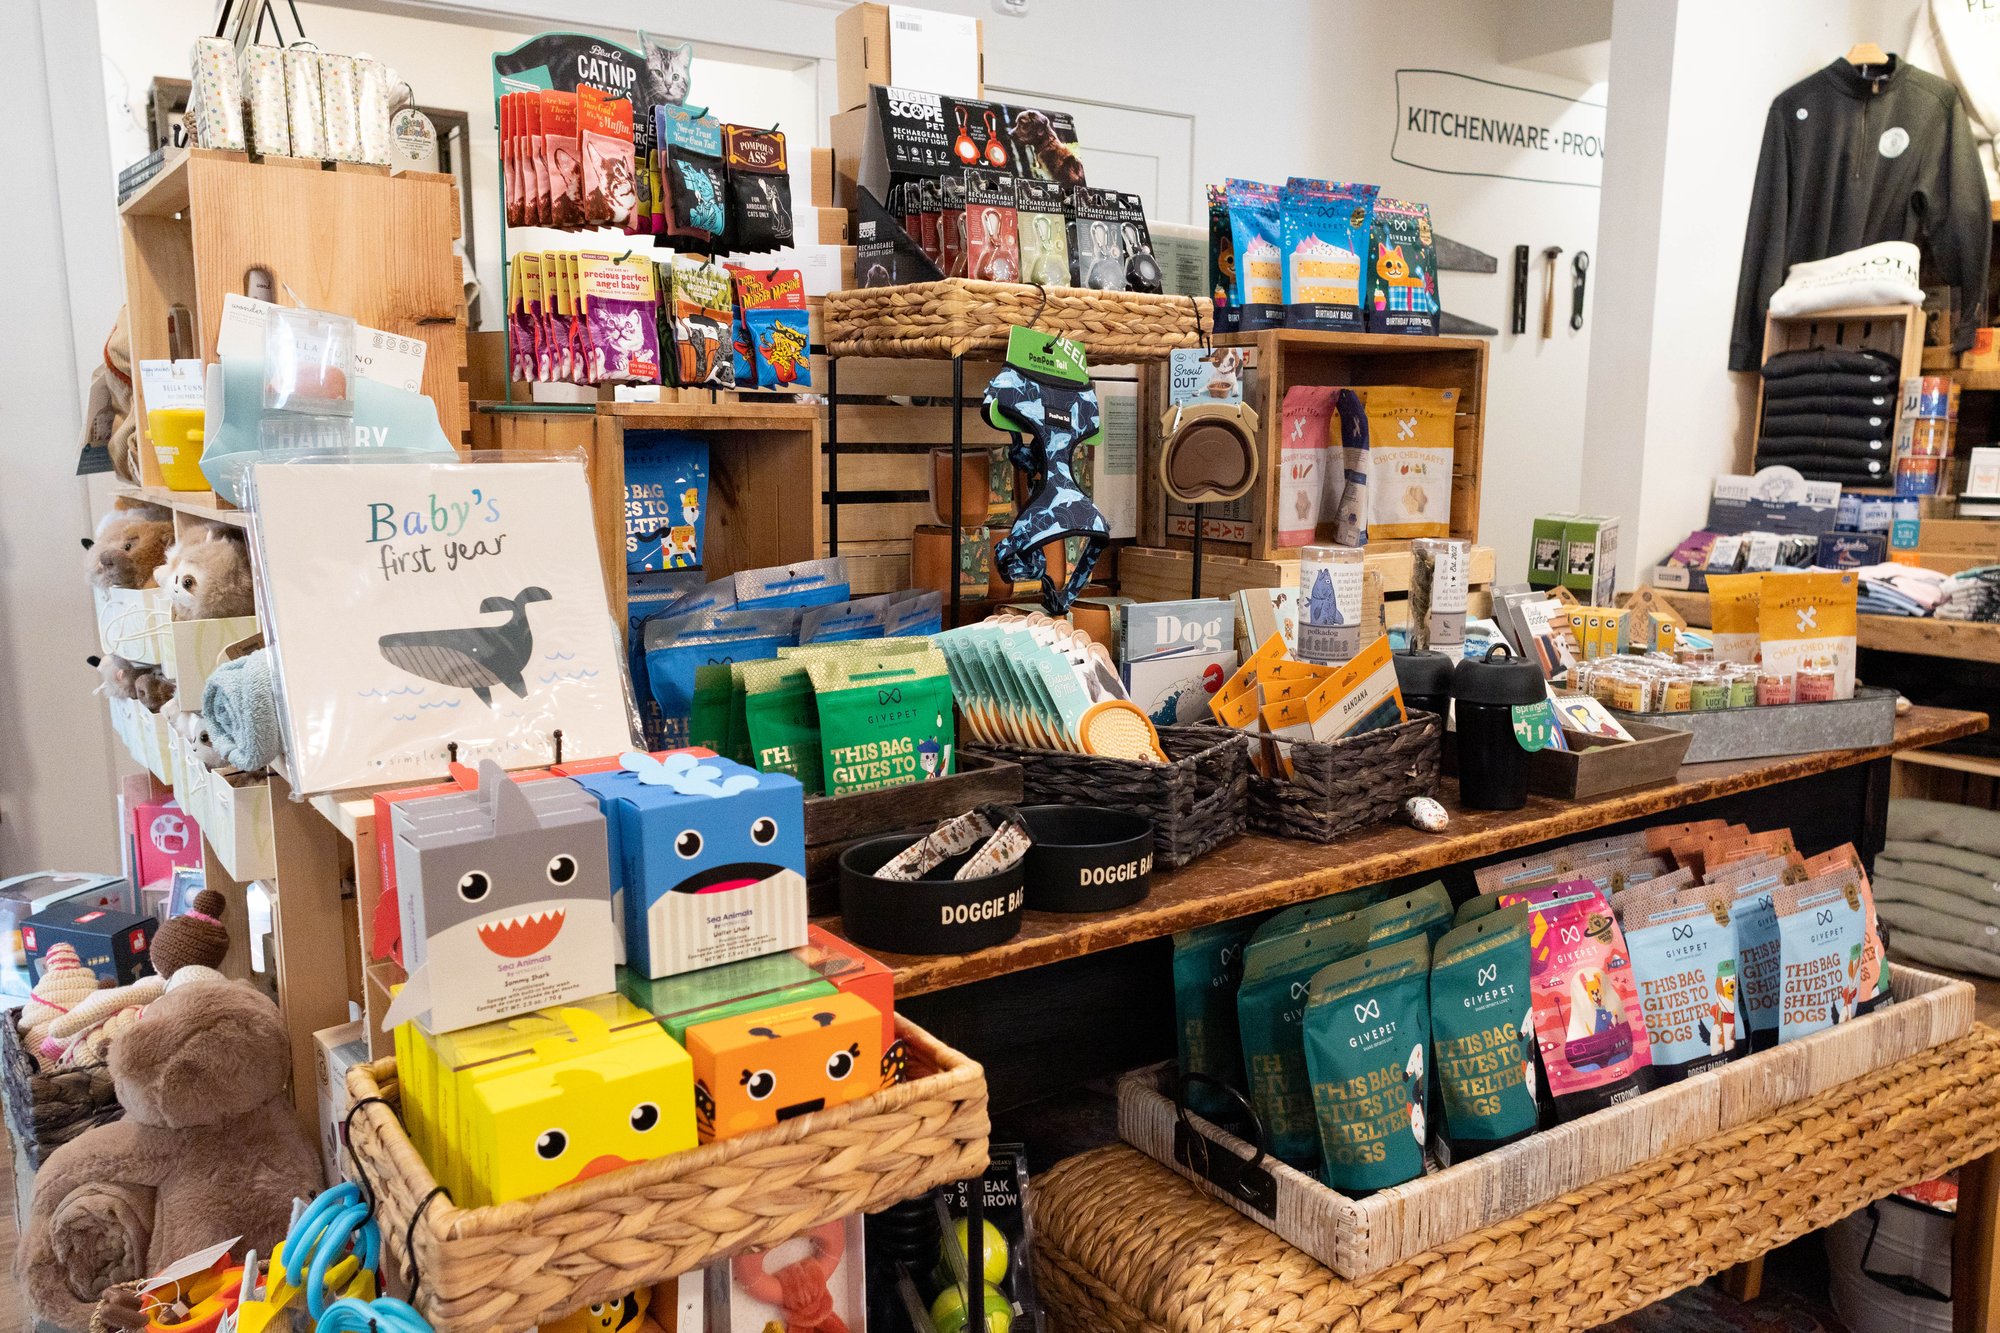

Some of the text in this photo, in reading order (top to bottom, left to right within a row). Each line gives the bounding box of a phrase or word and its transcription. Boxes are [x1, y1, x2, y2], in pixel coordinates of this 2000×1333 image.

[589, 45, 623, 62] Blue Q
[577, 54, 637, 90] CATNIP
[888, 101, 945, 123] SCOPE
[676, 123, 712, 139] Never Trust
[892, 126, 948, 141] RECHARGEABLE
[925, 121, 945, 132] PET
[1408, 106, 1549, 151] KITCHENWARE
[672, 131, 718, 150] Your Own Tail
[739, 141, 774, 155] POMPOUS
[893, 133, 949, 147] PET SAFETY LIGHT
[747, 152, 767, 165] ASS
[967, 191, 1014, 201] RECHARGEABLE
[1019, 200, 1062, 208] RECHARGEABLE
[758, 211, 770, 219] ONLY
[1077, 207, 1119, 216] RECHARGEABLE
[858, 228, 876, 239] SCOPE
[1388, 233, 1416, 243] GIVEPET
[858, 241, 894, 252] RECHARGEABLE
[881, 248, 894, 256] LIGHT
[584, 270, 650, 283] precious perfect
[595, 280, 641, 291] angel baby
[742, 290, 771, 308] MURDER
[771, 278, 801, 301] MACHINE
[1315, 309, 1354, 320] BIRTHDAY BASH
[1386, 317, 1408, 326] BIRTHDAY
[1028, 352, 1055, 367] PomPom
[1055, 359, 1068, 370] Tail
[1174, 363, 1203, 377] Snout
[1173, 377, 1198, 389] OUT
[1414, 408, 1434, 418] PETS
[631, 484, 665, 499] BAG
[365, 488, 501, 543] Baby's
[644, 500, 669, 515] TO
[377, 531, 508, 582] first year
[1812, 596, 1835, 606] PETS
[1154, 615, 1223, 653] Dog
[1307, 628, 1339, 637] polkadog
[1342, 688, 1369, 715] BANDANA
[1515, 701, 1549, 715] springer
[867, 709, 918, 725] GIVEPET
[831, 736, 914, 767] THIS BAG
[832, 755, 916, 785] GIVES TO
[1080, 860, 1138, 887] DOGGIE
[706, 909, 753, 925] Sea Animals
[941, 898, 1006, 926] DOGGIE
[713, 925, 751, 938] Walter Whale
[1810, 926, 1845, 944] GIVEPET
[1557, 945, 1599, 965] GIVEPET
[1666, 942, 1709, 959] GIVEPET
[1741, 941, 1771, 964] THIS
[497, 954, 552, 973] Sea Animals
[1785, 952, 1841, 978] THIS BAG
[504, 977, 530, 988] Sammy
[531, 971, 550, 981] Shark
[1641, 969, 1706, 996] THIS BAG
[1785, 969, 1843, 994] GIVES TO
[1463, 984, 1516, 1009] GIVEPET
[1644, 985, 1709, 1012] GIVES TO
[1784, 985, 1845, 1010] SHELTER
[1644, 1002, 1712, 1029] SHELTER
[1783, 1008, 1827, 1026] DOGS
[1349, 1021, 1398, 1049] GIVEPET
[1436, 1022, 1518, 1058] THIS BAG
[1649, 1025, 1693, 1045] DOGS
[1440, 1043, 1522, 1079] GIVES TO
[1314, 1062, 1403, 1103] THIS BAG
[1318, 1084, 1407, 1126] GIVES TO
